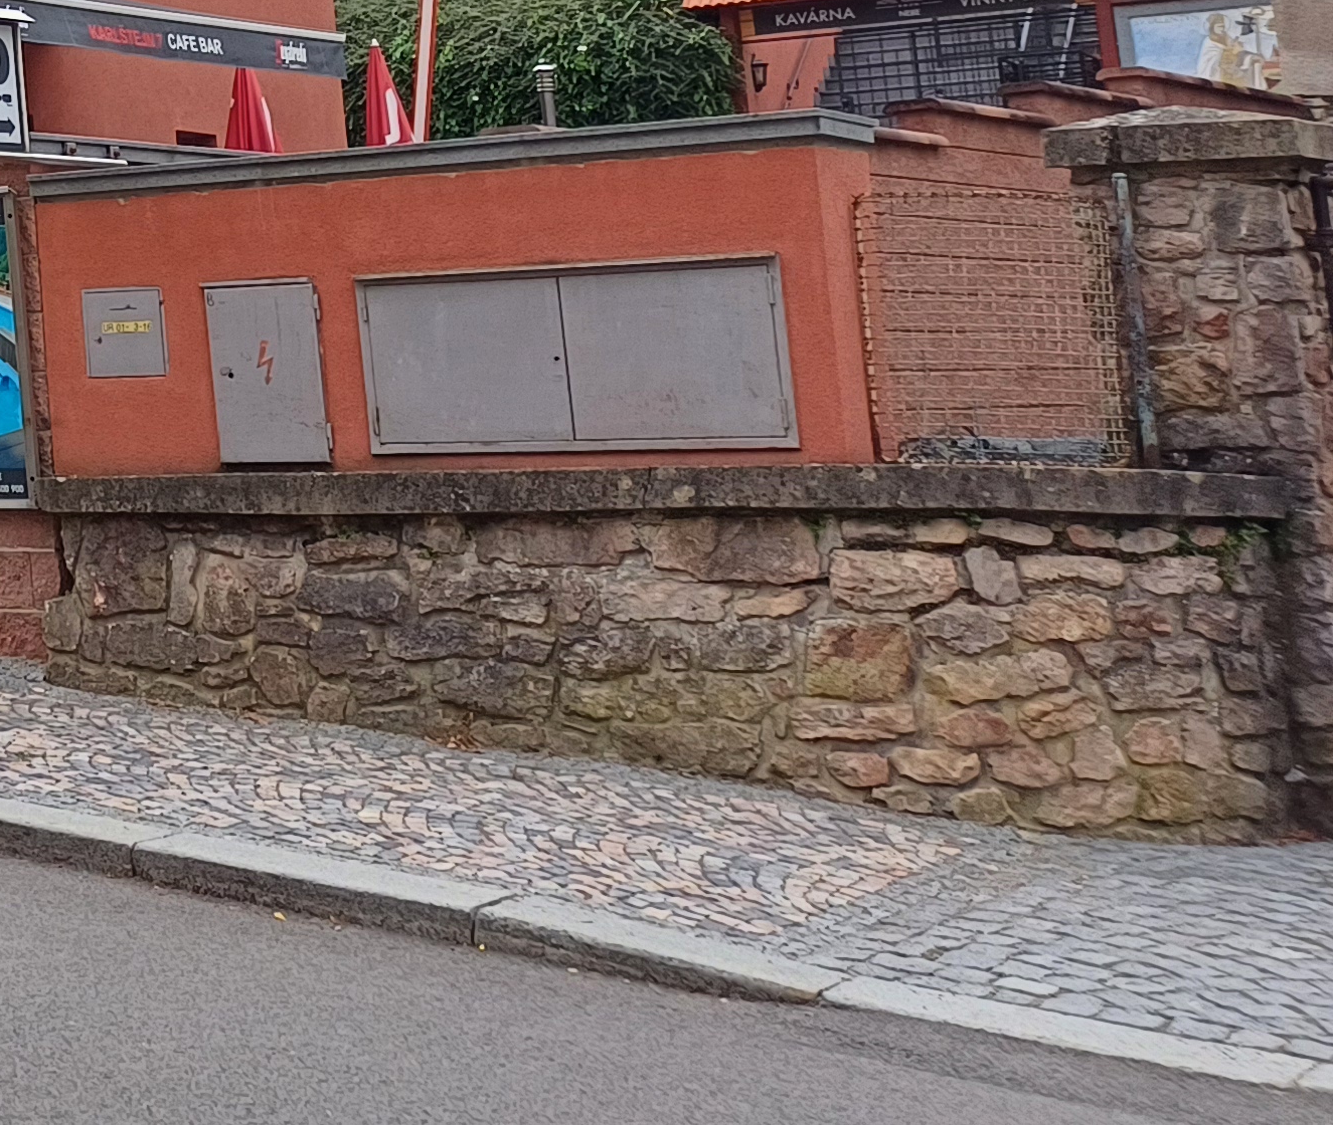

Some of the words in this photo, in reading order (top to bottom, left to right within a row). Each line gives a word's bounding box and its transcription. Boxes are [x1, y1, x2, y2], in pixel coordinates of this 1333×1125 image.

[774, 6, 856, 27] KAVÁRNA
[167, 32, 199, 53] CAFE
[199, 35, 224, 56] BAR
